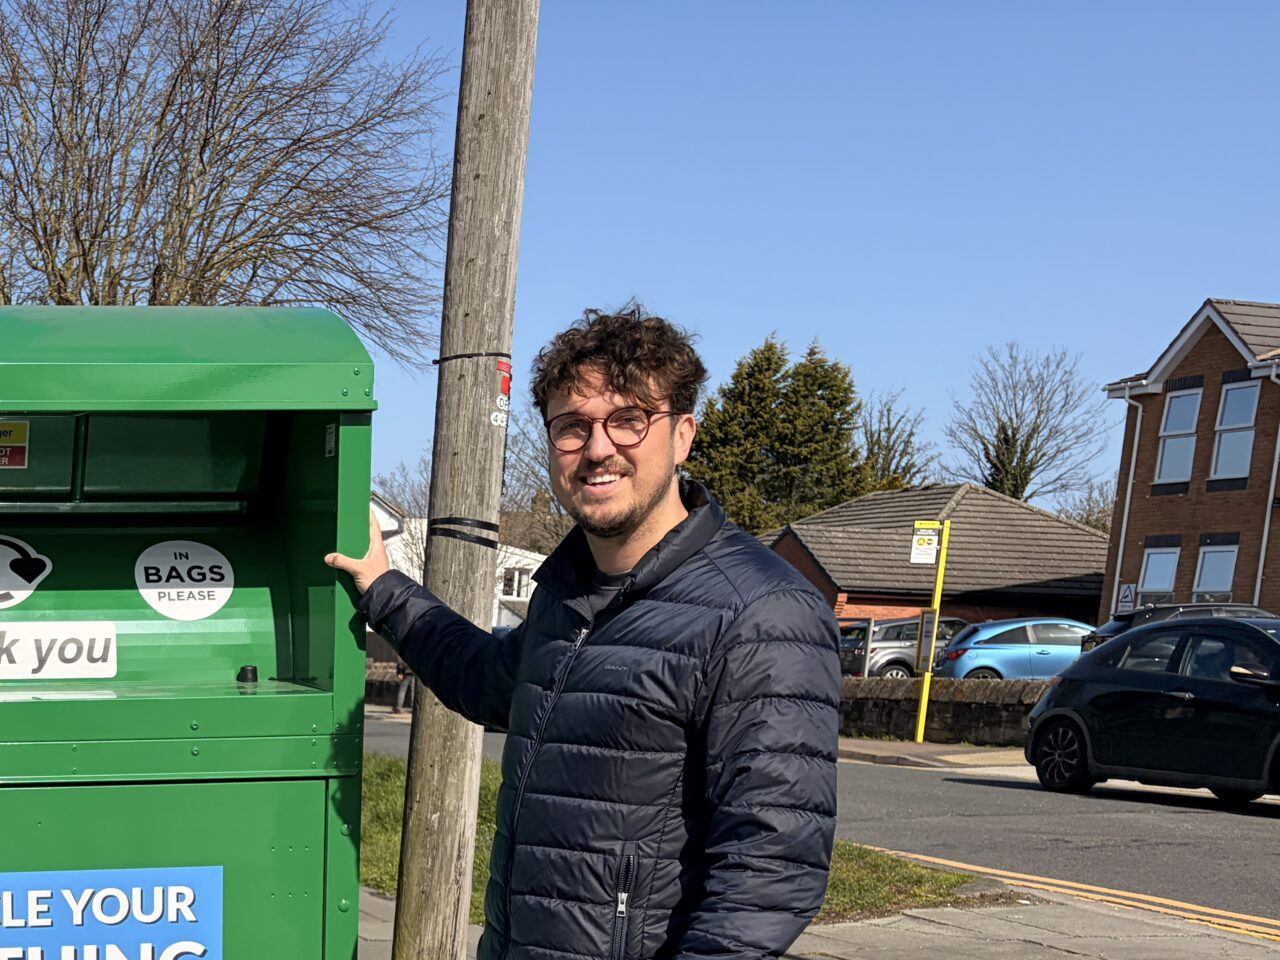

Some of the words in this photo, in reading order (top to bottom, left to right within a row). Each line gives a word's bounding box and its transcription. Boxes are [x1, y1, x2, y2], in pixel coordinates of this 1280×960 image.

[173, 552, 190, 561] IN
[143, 565, 225, 584] BAGS
[158, 590, 216, 602] PLEASE
[31, 637, 112, 675] you
[60, 885, 197, 926] YOUR
